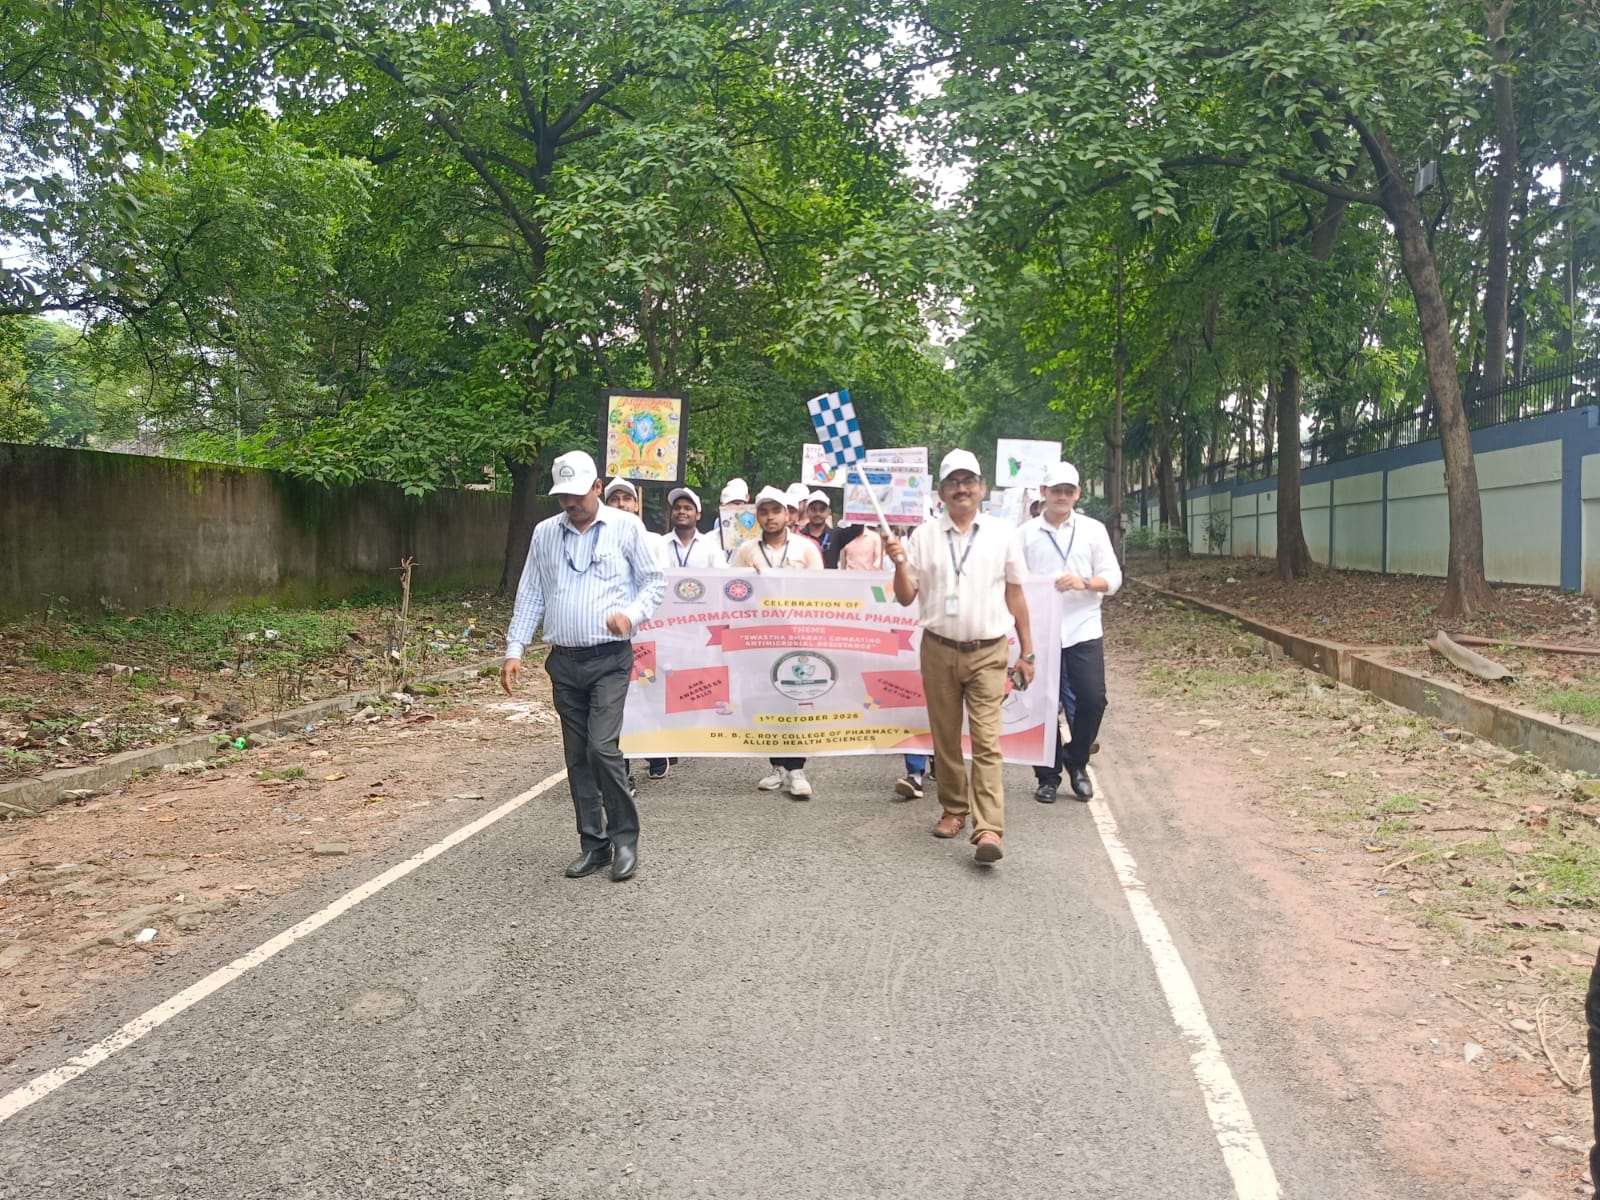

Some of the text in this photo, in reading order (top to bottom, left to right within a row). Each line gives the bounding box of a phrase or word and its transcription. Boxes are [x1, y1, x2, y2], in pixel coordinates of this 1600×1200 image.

[764, 600, 860, 608] CELEBRATION OF
[638, 610, 921, 632] RLD PHARMACIST DAY/NATIONAL PHARMA
[792, 626, 826, 634] THEME
[745, 640, 812, 648] ANTIMICROBIAL
[777, 714, 829, 723] OCTOBER
[781, 731, 826, 739] COLLEGE
[845, 728, 900, 736] PHARMACY
[743, 735, 876, 746] ALLIED HEALTH SCIENCES
